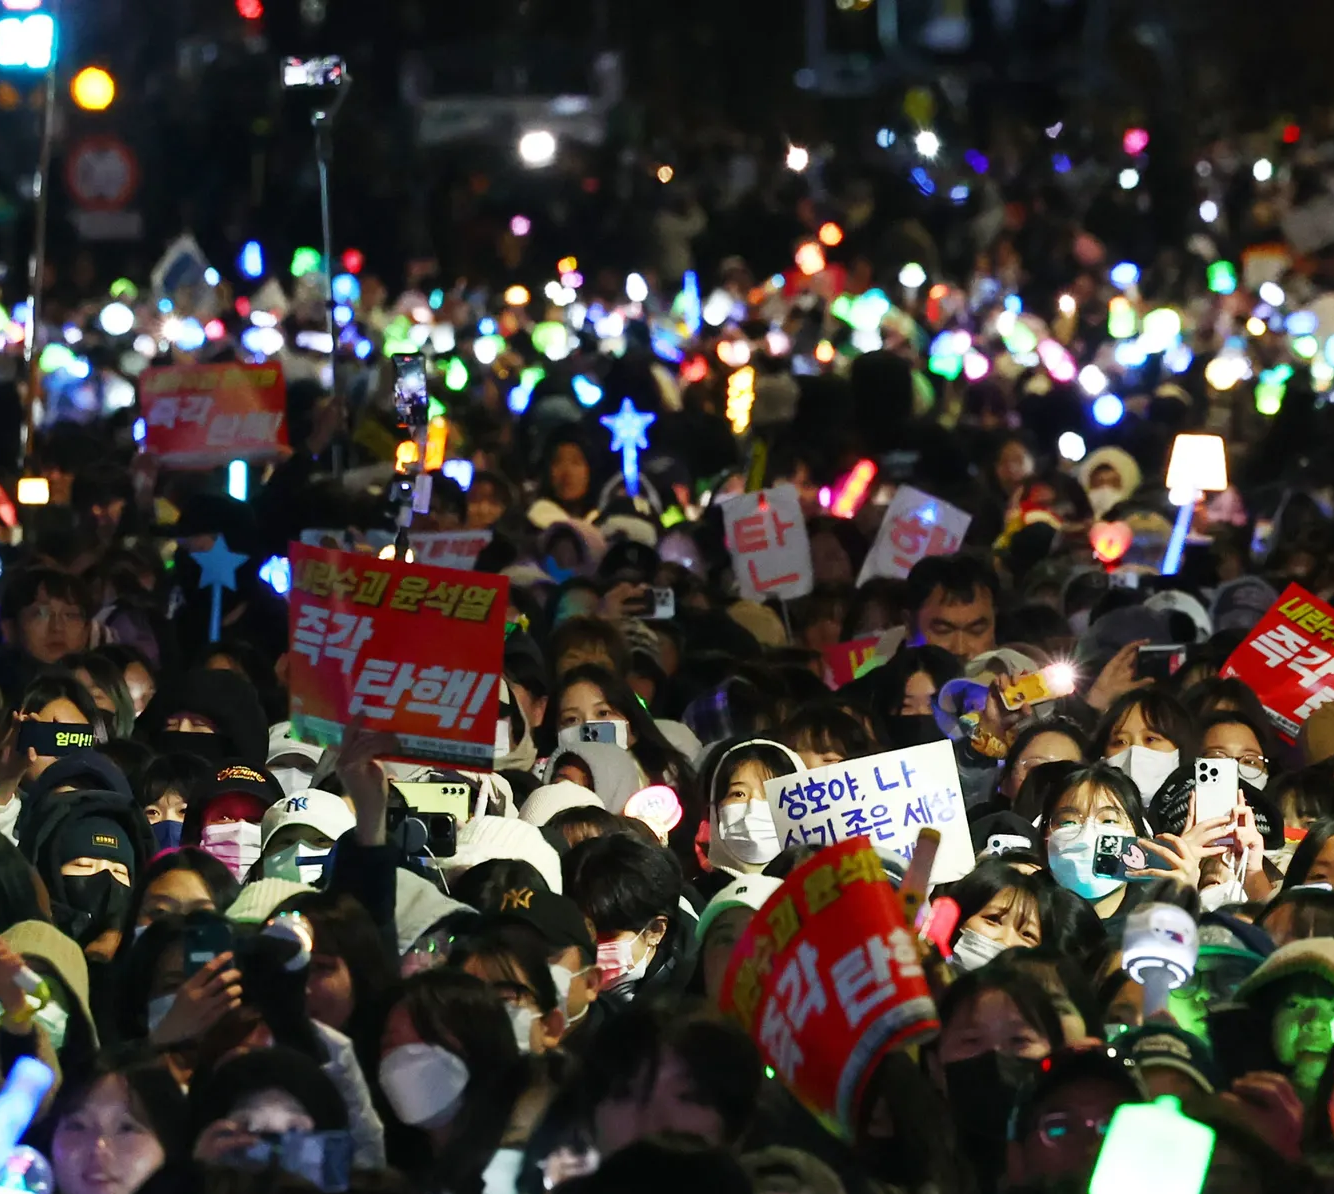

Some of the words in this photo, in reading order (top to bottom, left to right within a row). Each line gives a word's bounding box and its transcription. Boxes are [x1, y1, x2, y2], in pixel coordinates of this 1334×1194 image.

[733, 511, 800, 591] 탄
[294, 558, 391, 607] 내란수괴
[390, 575, 498, 621] 윤석열
[293, 603, 374, 673] 즉각
[348, 658, 497, 730] 탄핵!
[55, 731, 93, 748] 엄마!!
[778, 771, 866, 820] 성호야,
[873, 760, 916, 792] 나
[903, 788, 957, 827] 세상
[500, 886, 535, 912] NY
[759, 939, 827, 1083] 즉각
